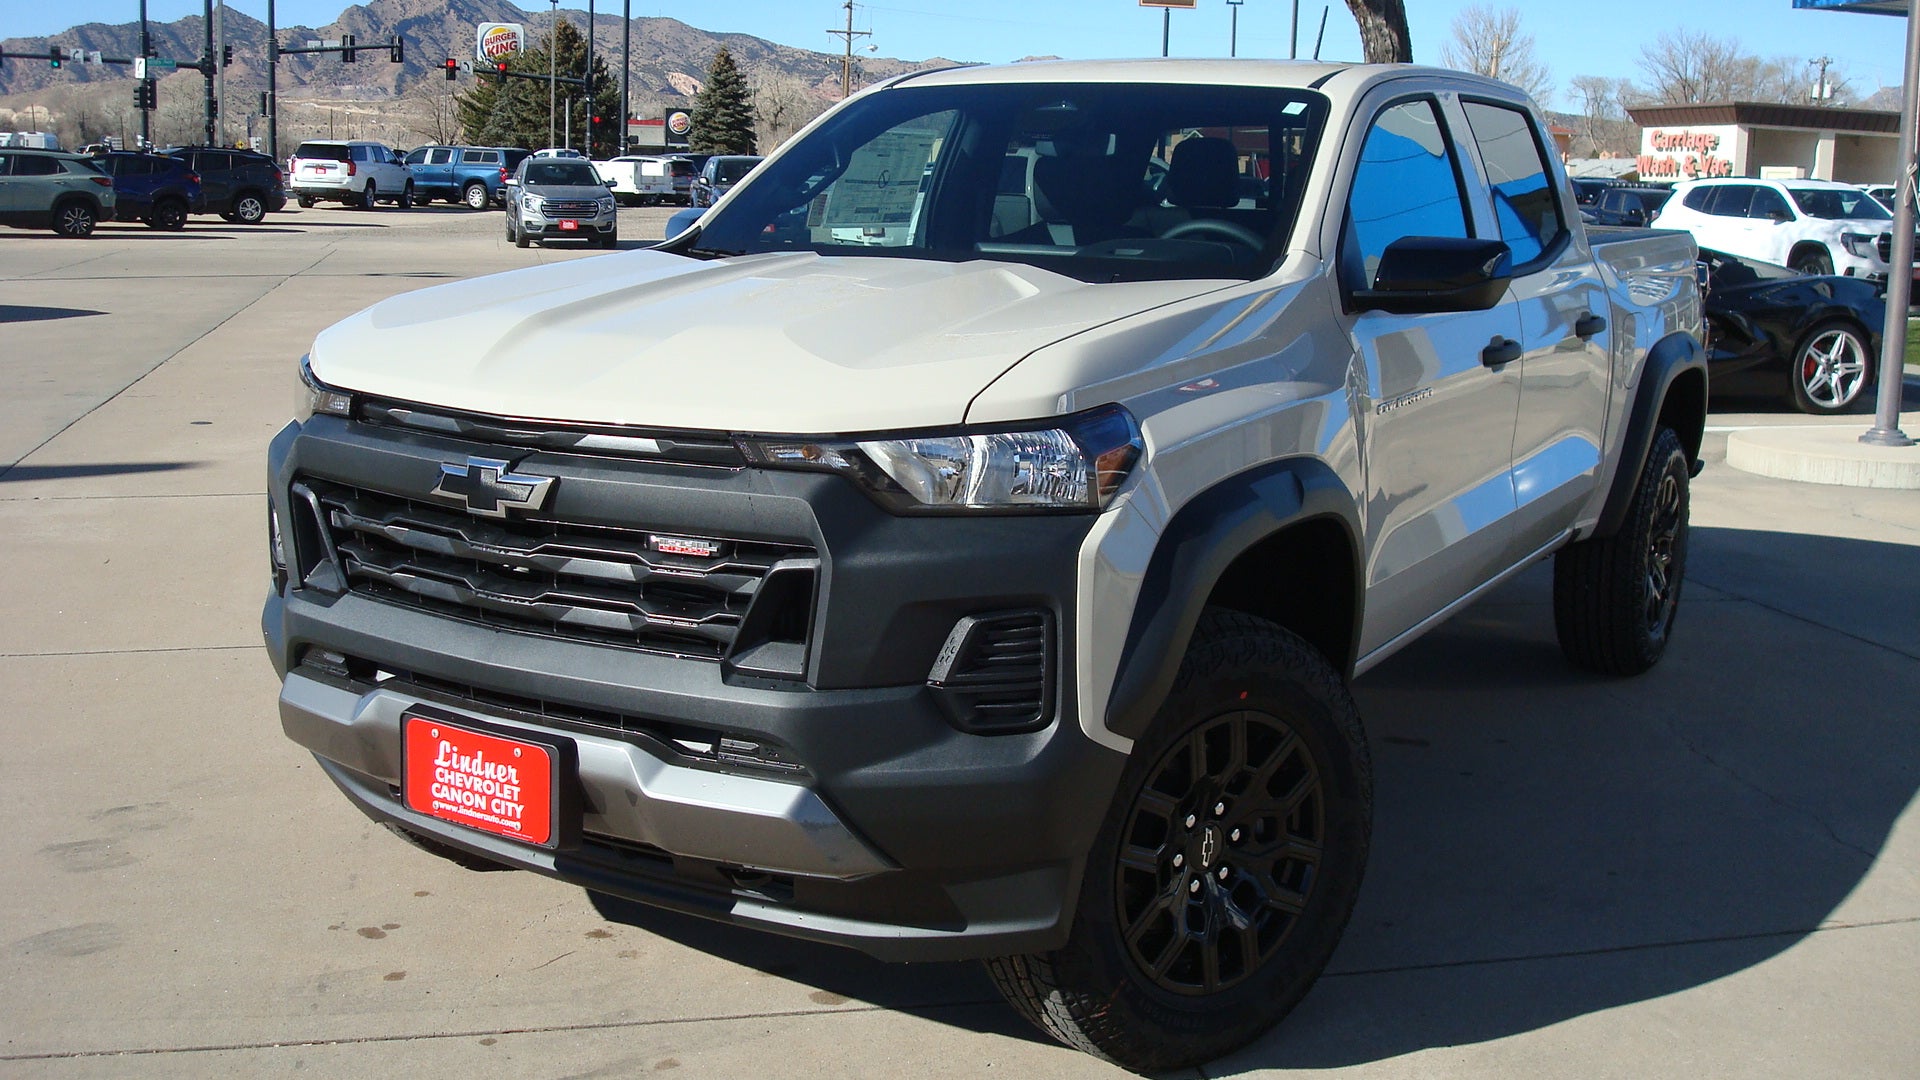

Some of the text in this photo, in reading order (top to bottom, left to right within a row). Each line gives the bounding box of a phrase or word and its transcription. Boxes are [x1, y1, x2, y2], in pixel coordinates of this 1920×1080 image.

[485, 32, 517, 46] BURGER
[487, 41, 518, 58] KING
[1651, 129, 1716, 153] Carriage
[1636, 154, 1730, 175] Wash & Vac
[434, 740, 520, 785] Lindner
[435, 767, 521, 802] CHEVROLET
[431, 782, 525, 819] CANON CITY
